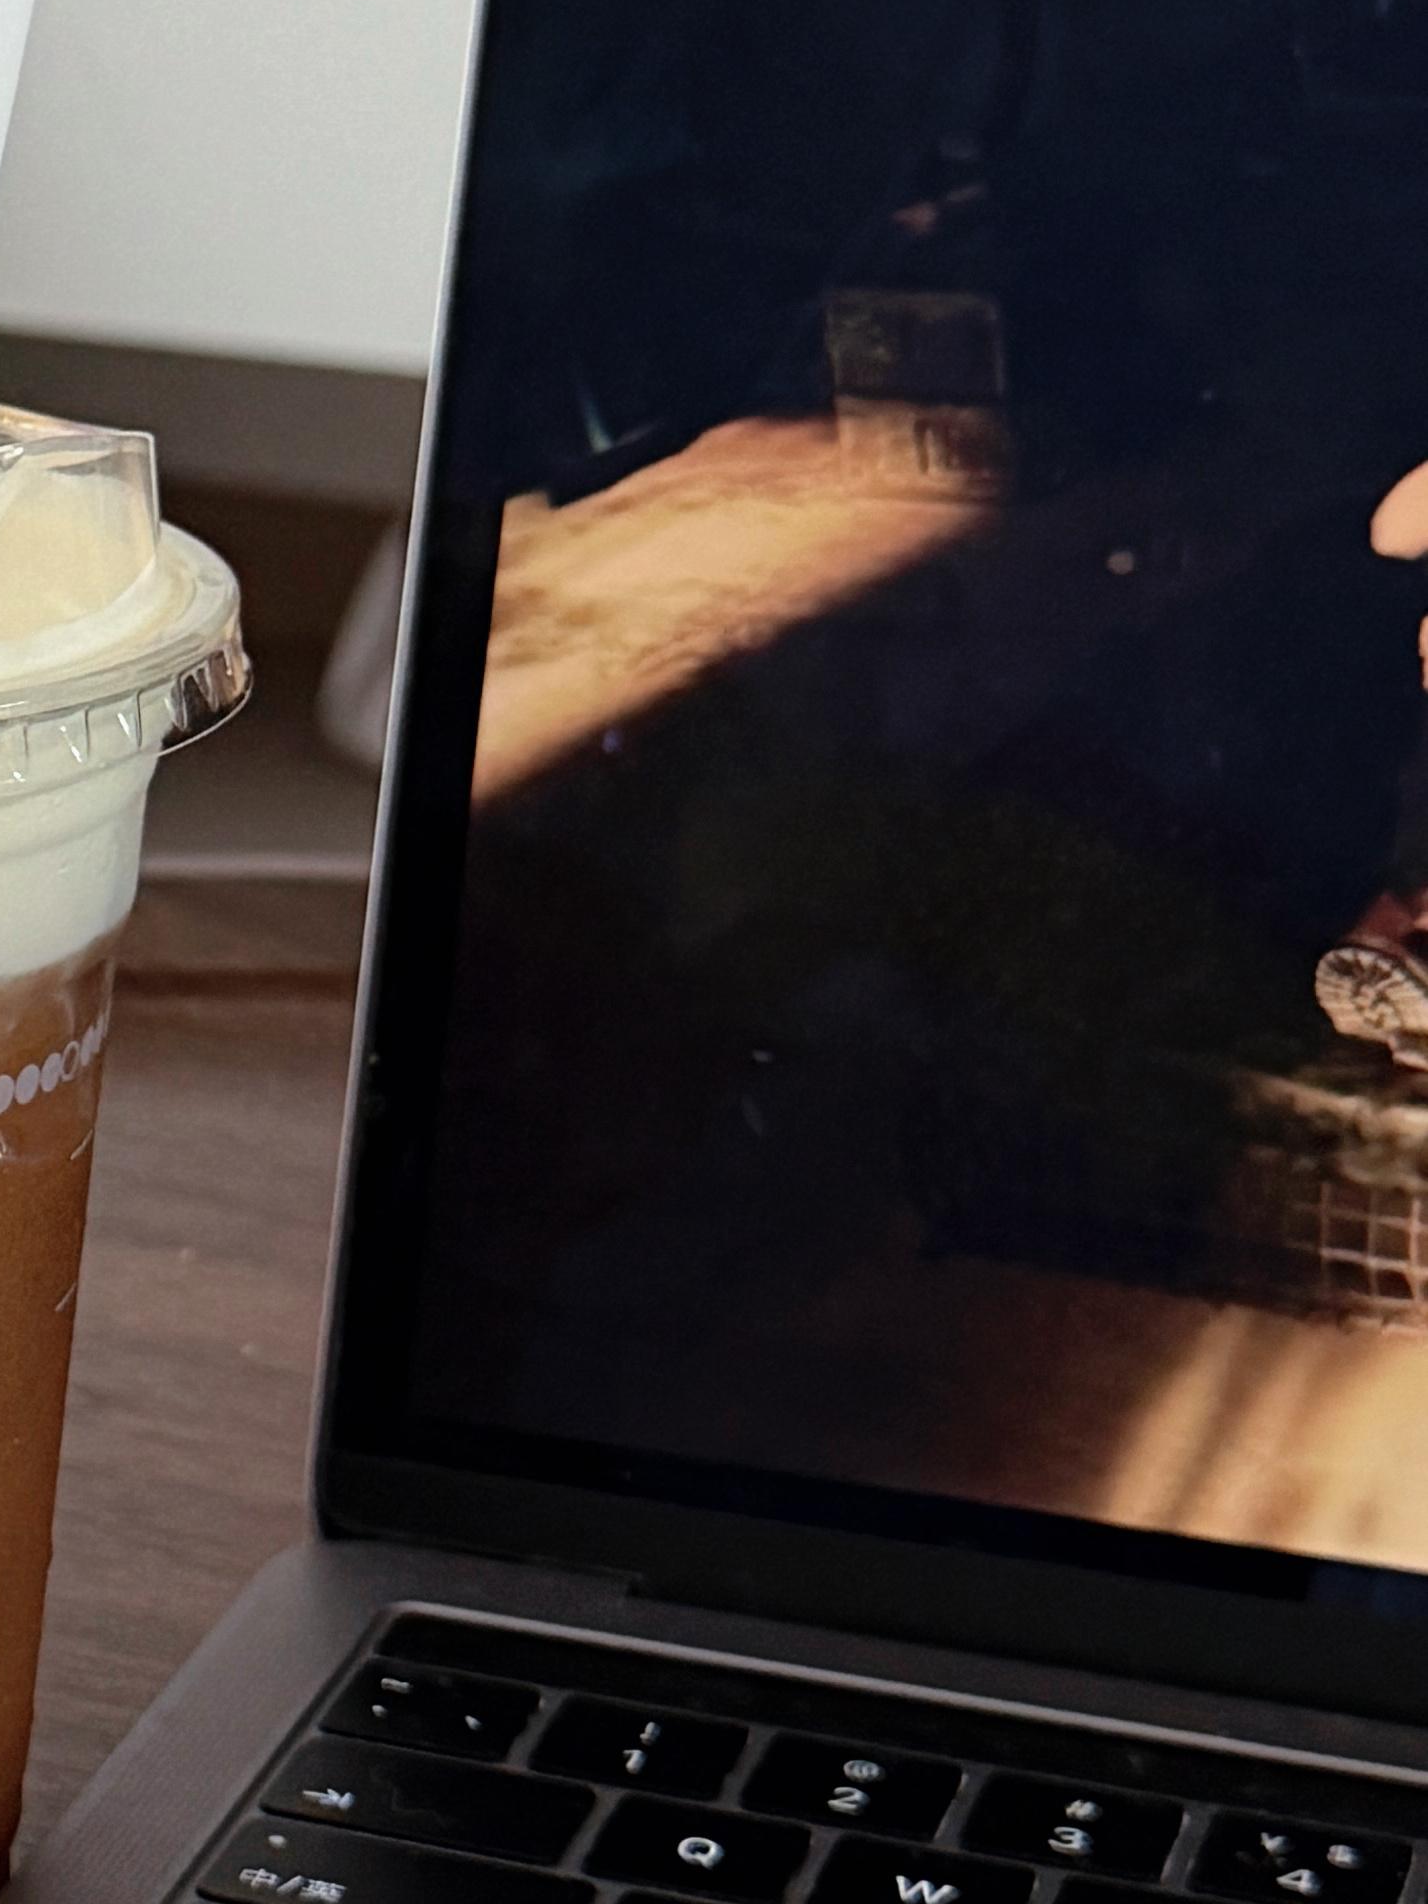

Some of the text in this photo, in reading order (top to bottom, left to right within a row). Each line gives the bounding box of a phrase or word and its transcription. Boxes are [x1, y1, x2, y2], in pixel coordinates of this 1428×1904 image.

[827, 1786, 869, 1815] 2
[677, 1836, 725, 1870] Q
[1047, 1826, 1093, 1855] 3
[1276, 1868, 1321, 1896] 4
